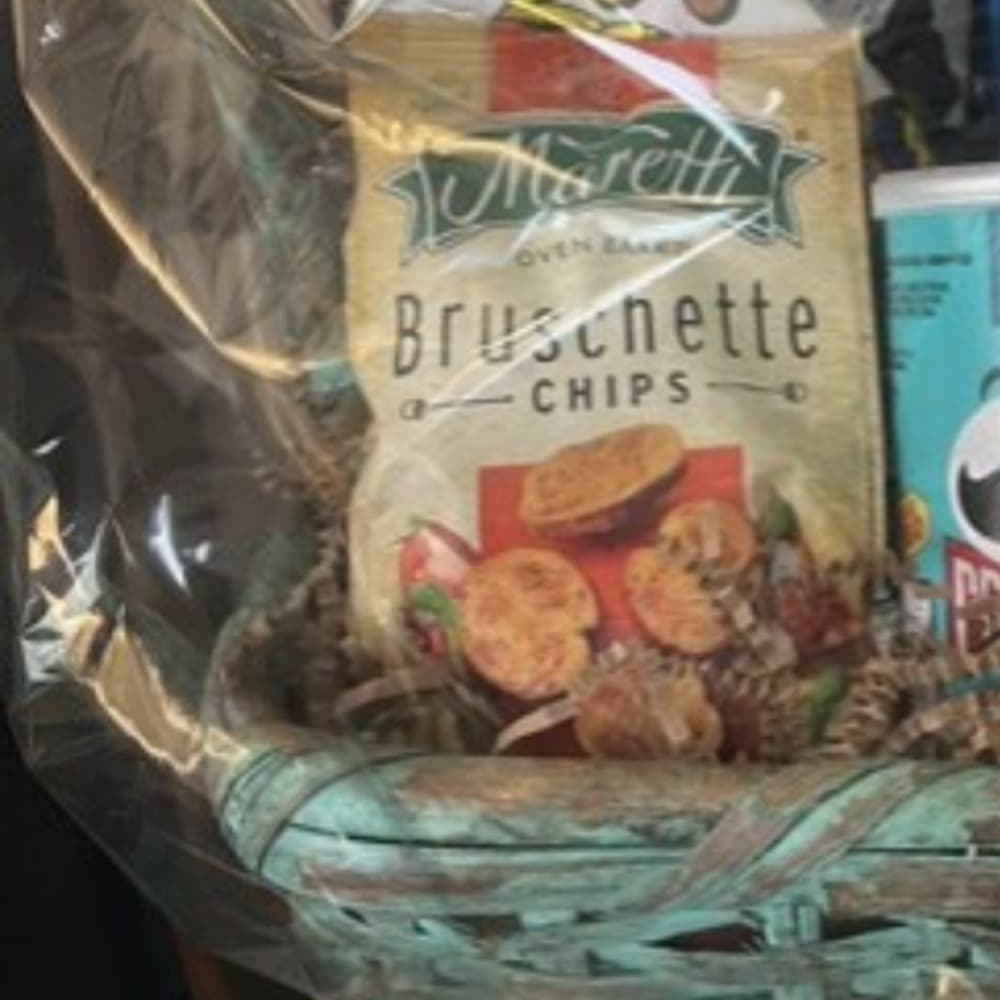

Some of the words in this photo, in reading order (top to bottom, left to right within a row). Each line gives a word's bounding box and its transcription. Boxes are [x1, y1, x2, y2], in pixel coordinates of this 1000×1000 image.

[515, 240, 592, 267] OVEN
[393, 279, 818, 376] Bruschette
[530, 370, 692, 414] CHIPS
